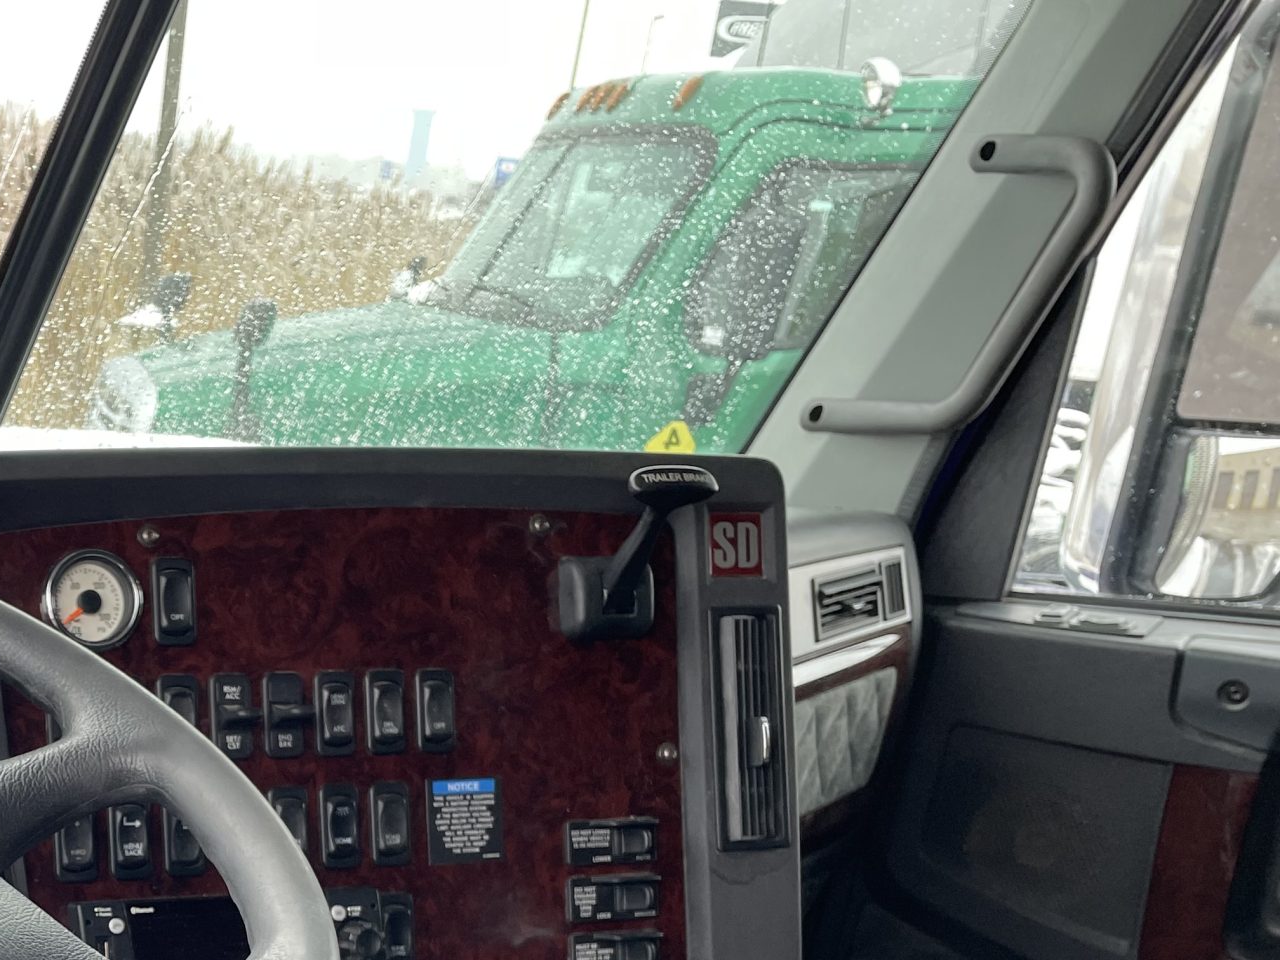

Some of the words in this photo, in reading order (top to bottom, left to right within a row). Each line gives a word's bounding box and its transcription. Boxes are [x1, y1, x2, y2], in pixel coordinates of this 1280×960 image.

[640, 472, 682, 483] TRAILER
[713, 521, 759, 569] SD
[447, 781, 480, 792] NOTICE
